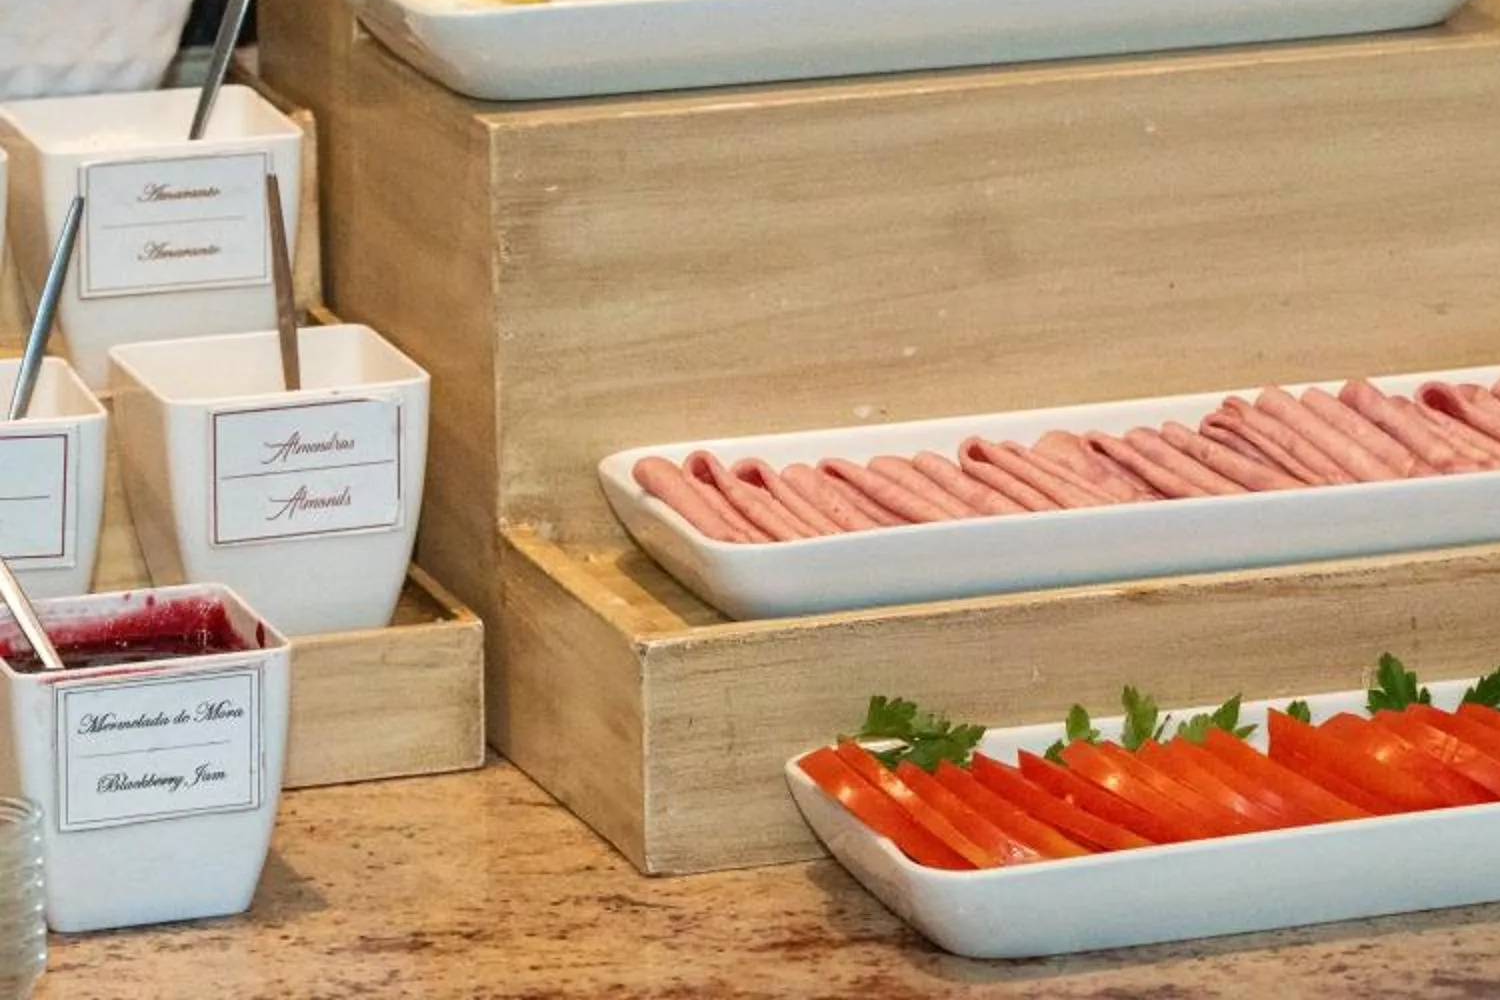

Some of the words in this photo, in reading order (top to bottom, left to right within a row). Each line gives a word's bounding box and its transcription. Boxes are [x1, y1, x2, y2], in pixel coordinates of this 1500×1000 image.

[261, 430, 355, 465] Almendras
[265, 484, 352, 520] Almonds
[77, 711, 170, 735] Mermelada
[173, 709, 190, 724] de
[193, 700, 245, 723] Mora
[185, 762, 226, 786] Jam
